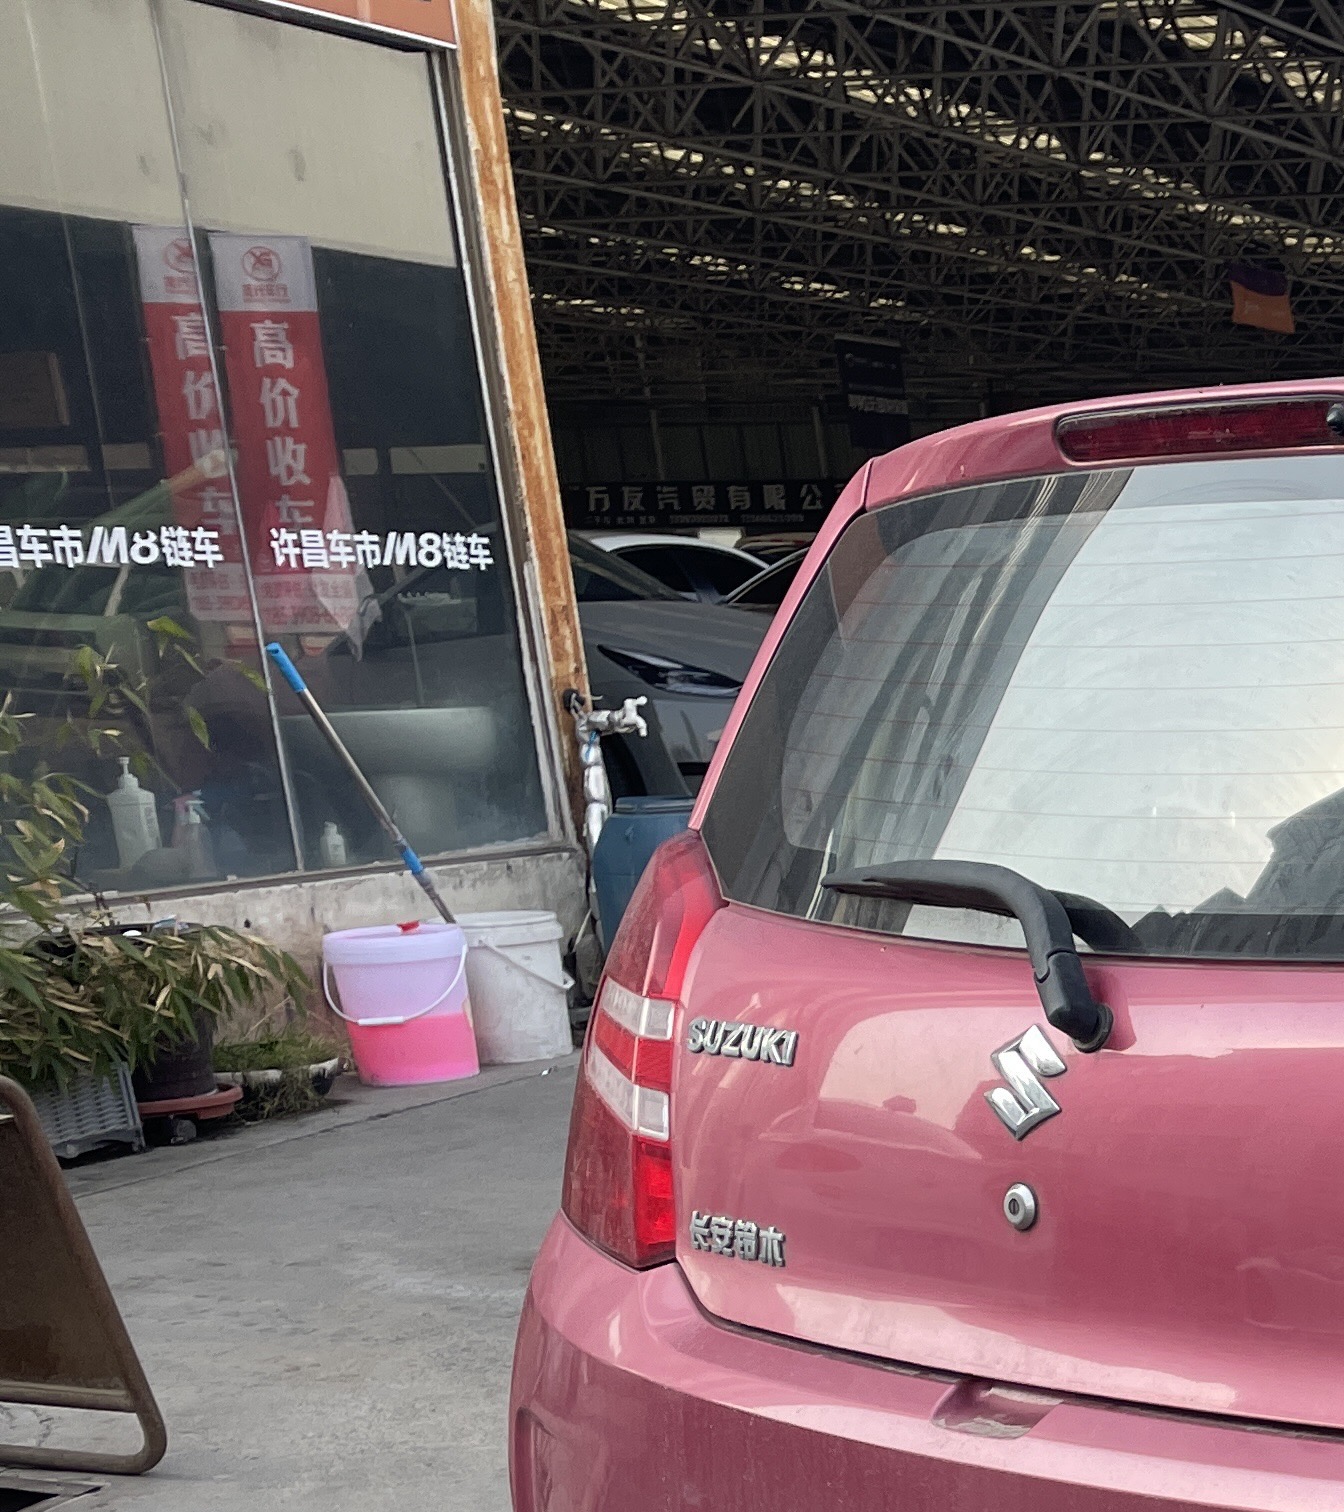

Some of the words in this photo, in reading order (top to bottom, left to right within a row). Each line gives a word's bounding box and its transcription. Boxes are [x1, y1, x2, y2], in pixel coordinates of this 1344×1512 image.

[250, 319, 315, 533] 高价收车
[569, 483, 845, 511] 万友汽贸有限公
[269, 526, 494, 571] 许昌车市M8链车
[687, 1017, 798, 1067] SUZUKI
[690, 1210, 785, 1267] 长安铃木
